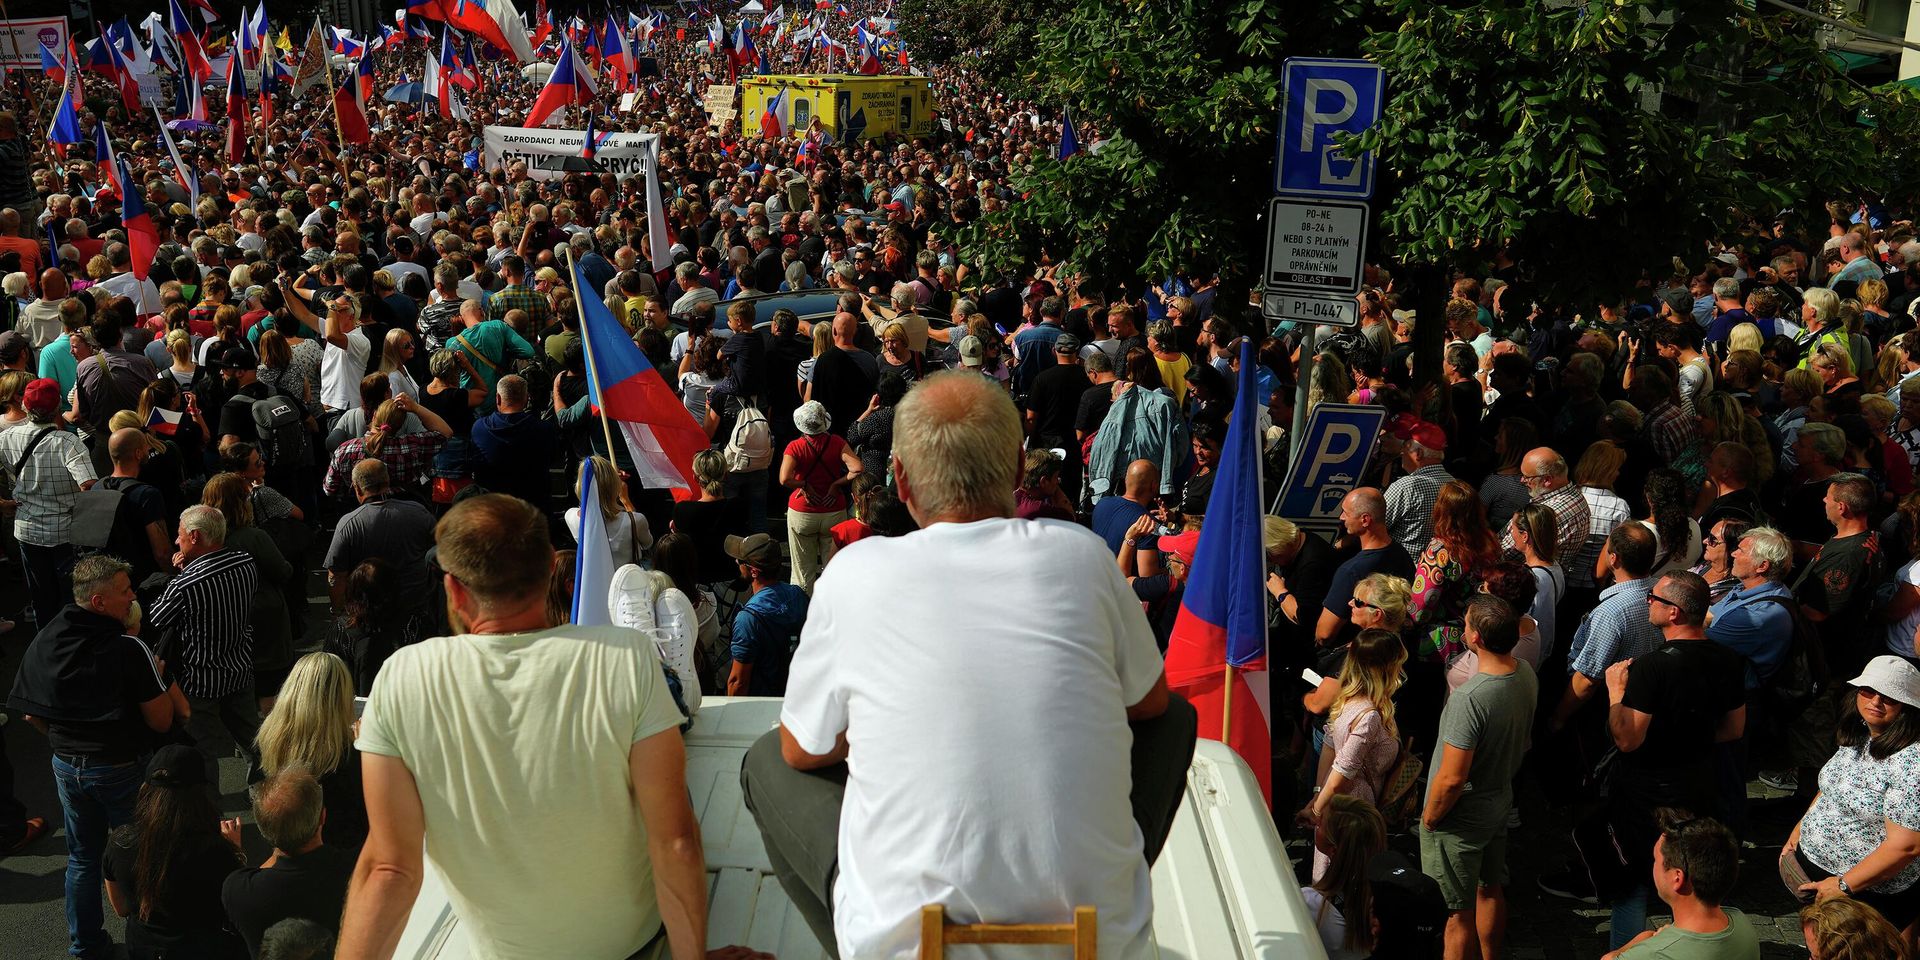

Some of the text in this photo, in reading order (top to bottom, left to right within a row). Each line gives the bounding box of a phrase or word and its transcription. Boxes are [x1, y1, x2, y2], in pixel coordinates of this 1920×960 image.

[41, 34, 57, 42] STOP
[1301, 78, 1358, 152] P
[503, 135, 555, 145] ZAPRODANCI
[626, 141, 647, 149] MAFI
[1306, 209, 1332, 219] PO-NE
[1301, 222, 1334, 233] 08-24 h
[1283, 234, 1350, 248] NEBO S PLATNÝM
[1291, 248, 1339, 260] PARKOVACÍM
[1289, 260, 1338, 273] OPRÁVNĚNÍM
[1291, 274, 1334, 285] OBLAST 1
[1294, 301, 1343, 319] P1-0447
[1303, 423, 1361, 488] P
